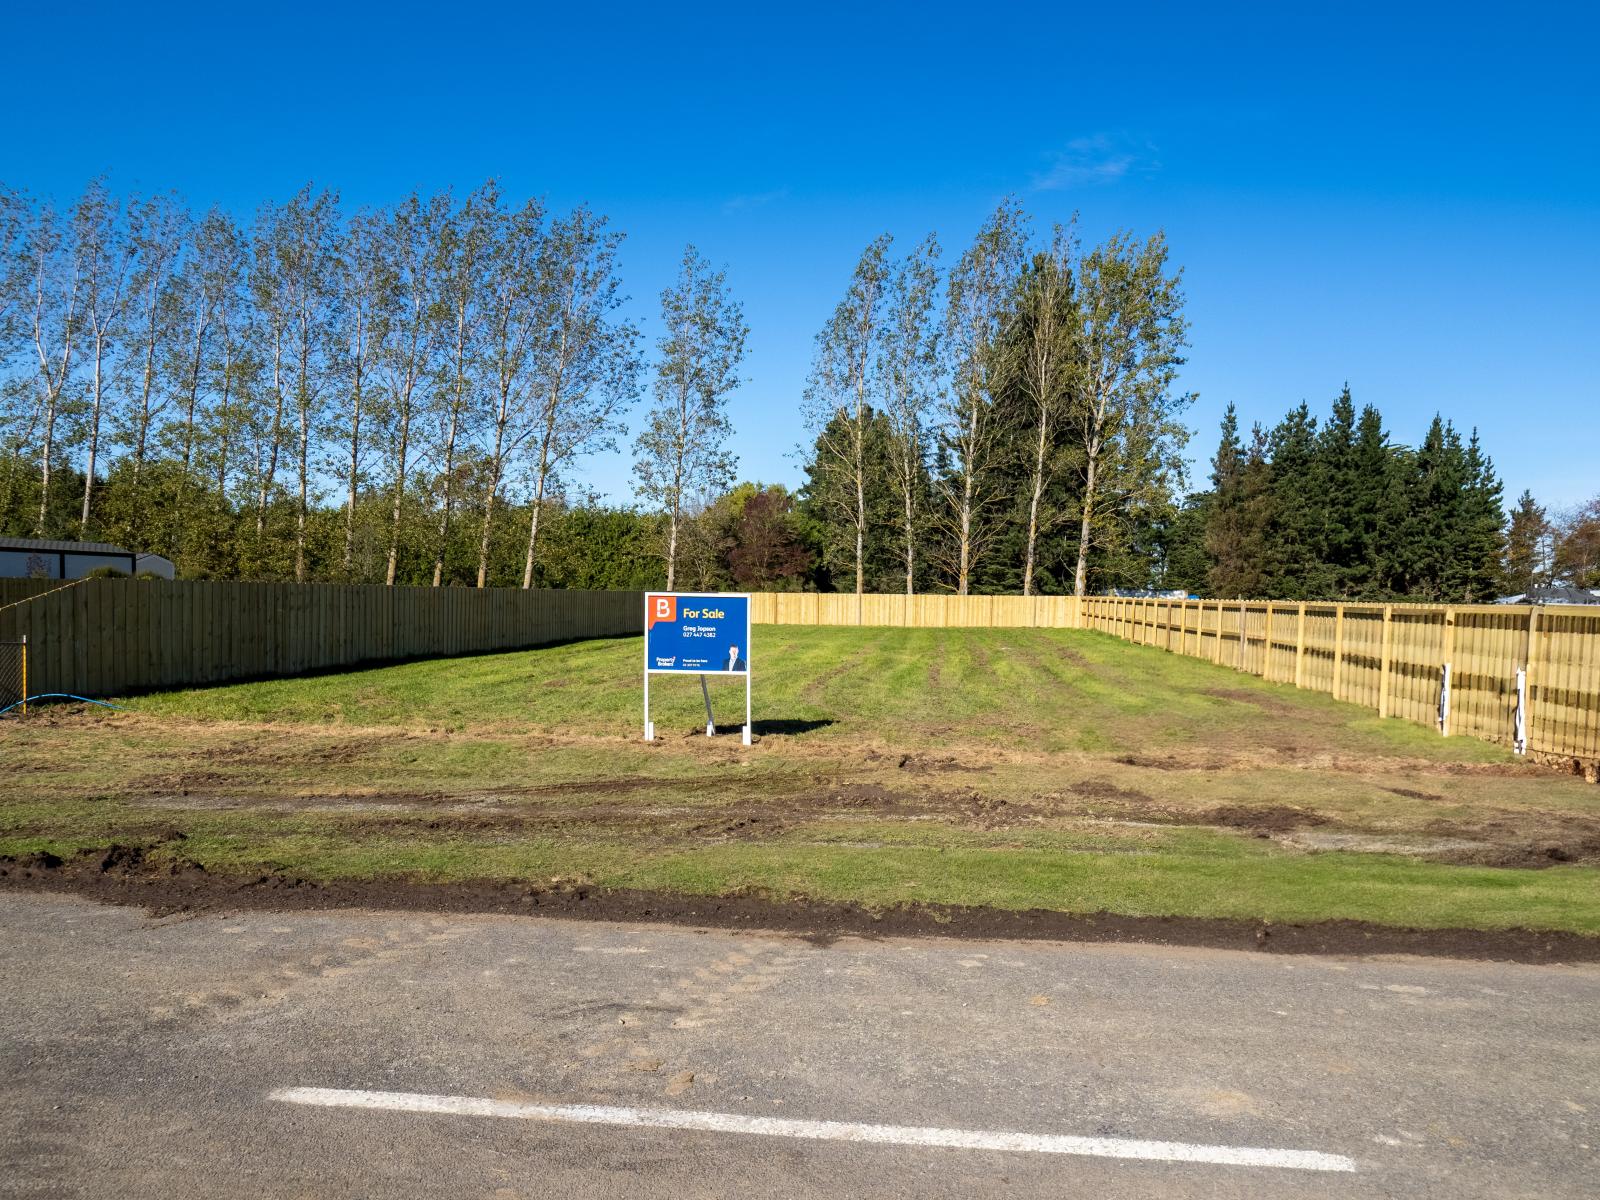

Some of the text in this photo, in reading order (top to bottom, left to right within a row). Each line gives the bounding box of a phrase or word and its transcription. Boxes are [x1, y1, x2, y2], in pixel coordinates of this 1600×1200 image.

[656, 599, 670, 618] B
[683, 608, 725, 619] For Sale
